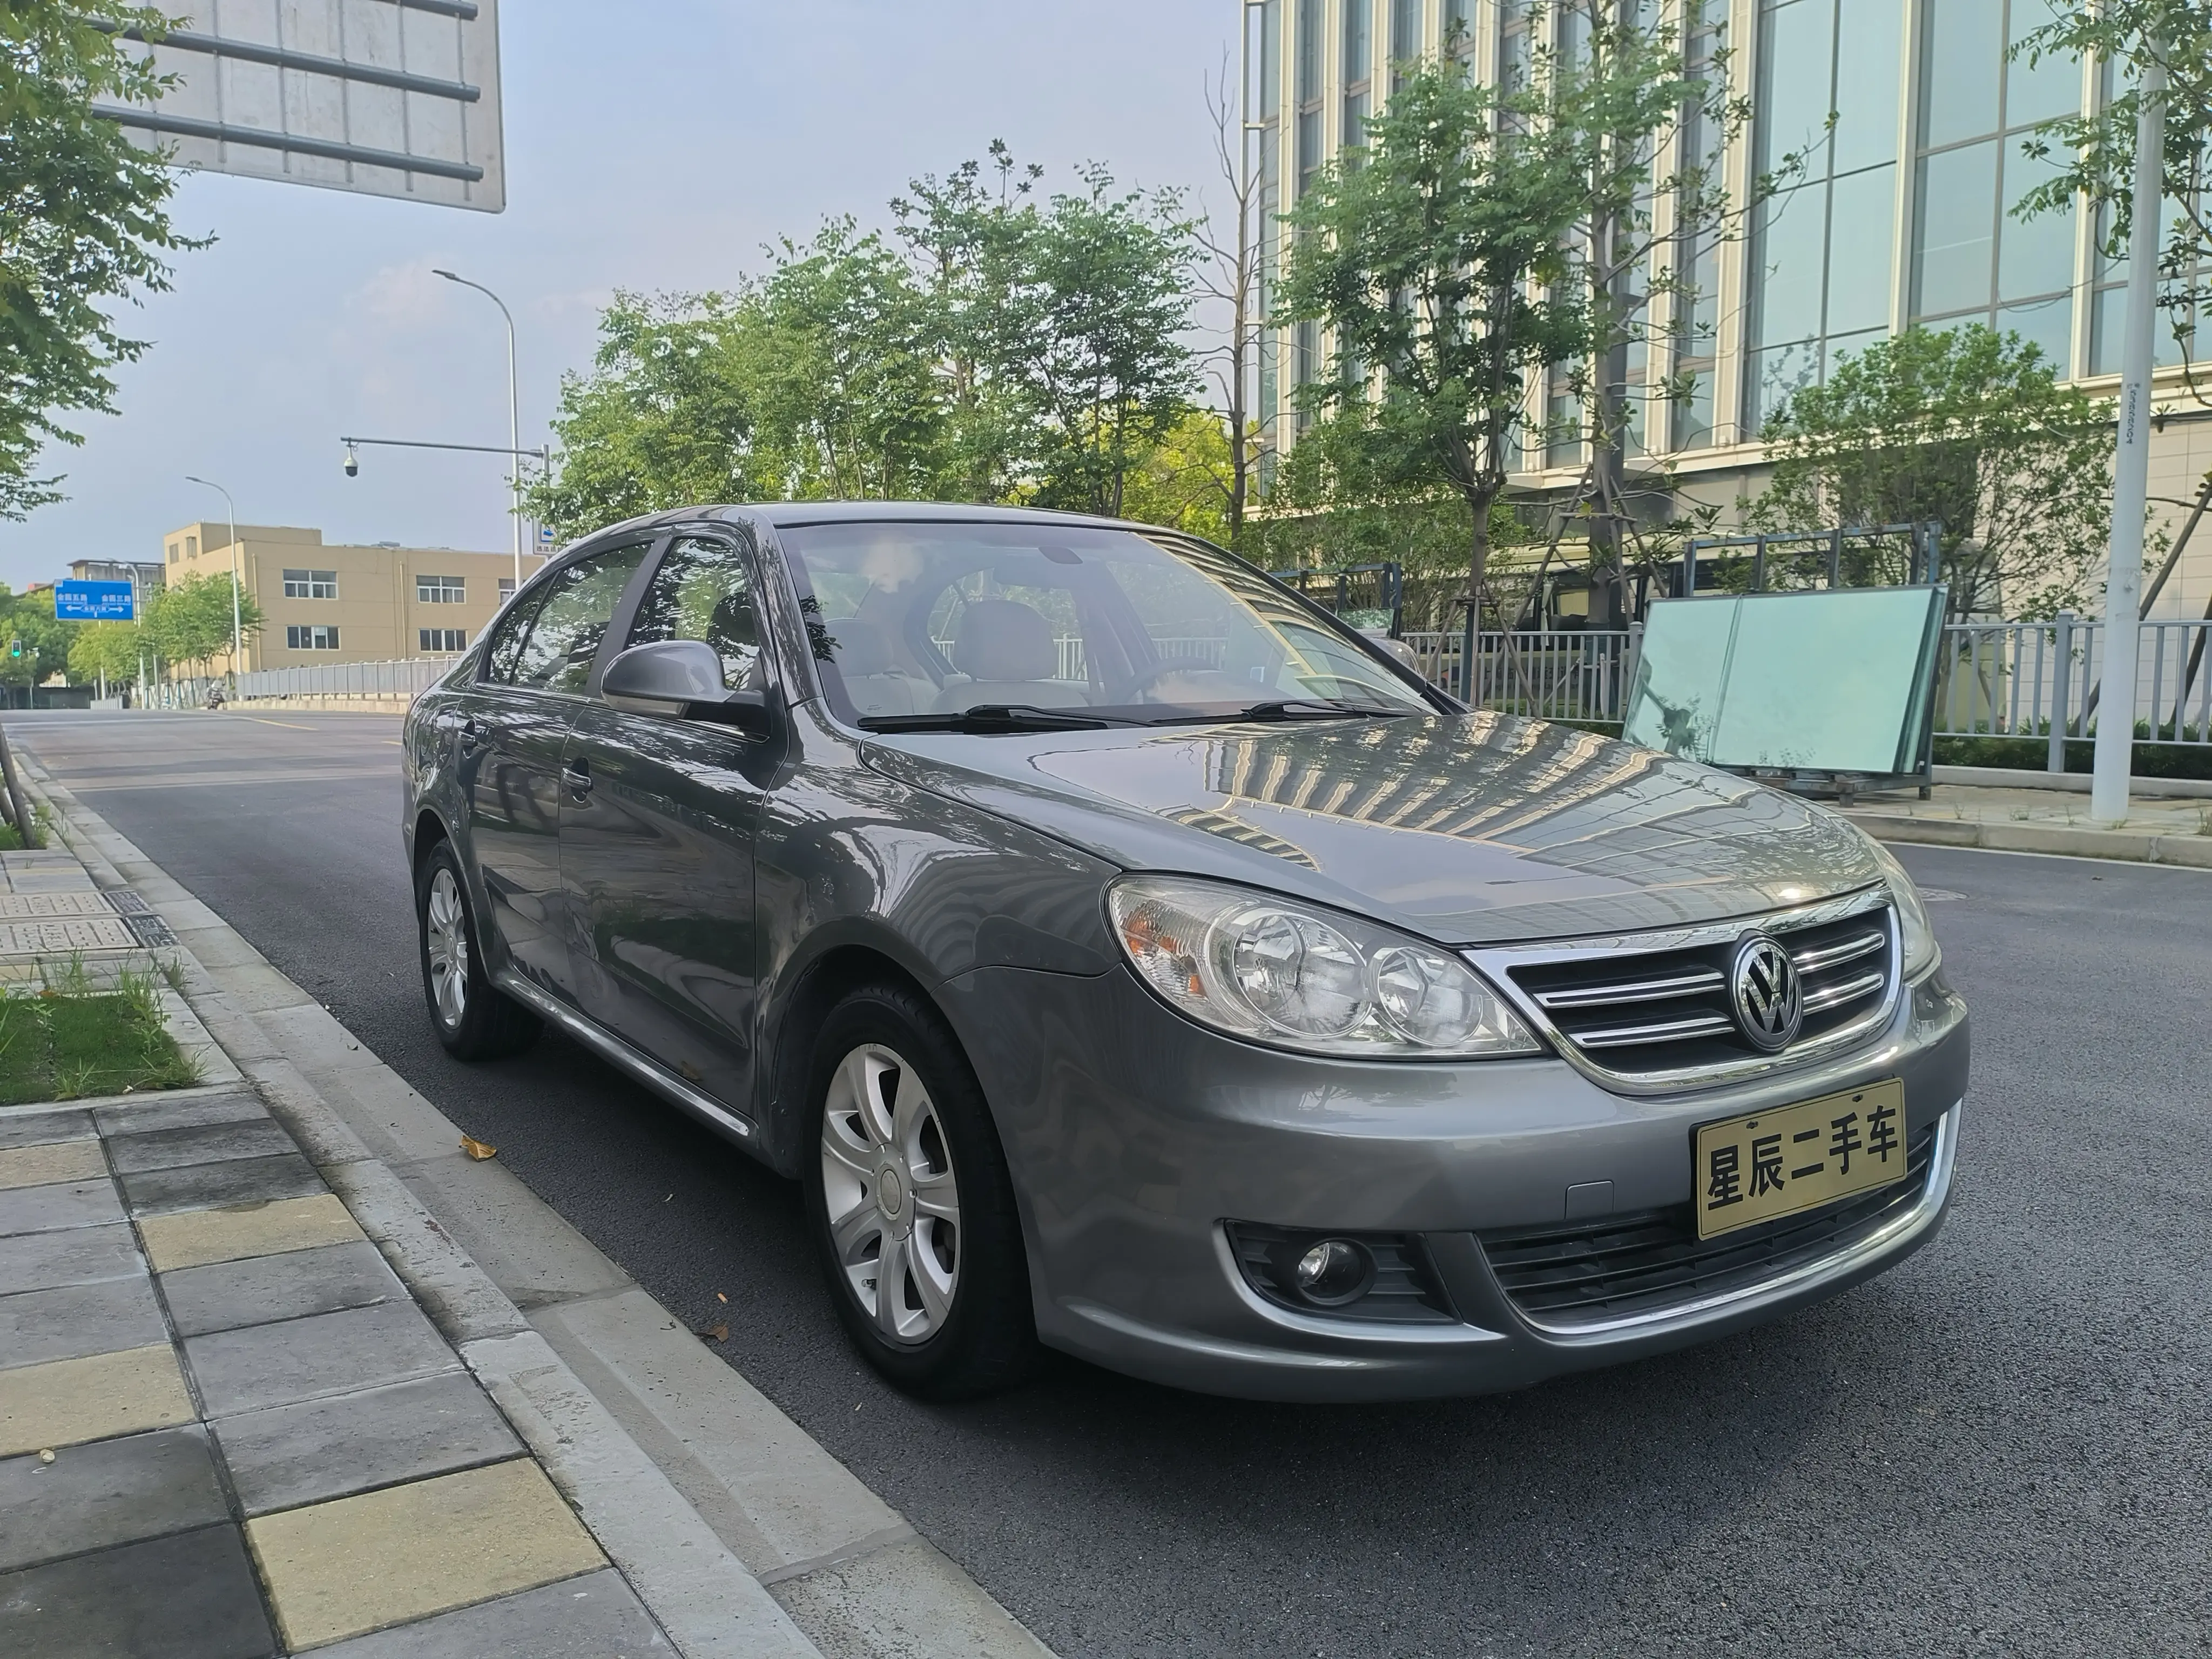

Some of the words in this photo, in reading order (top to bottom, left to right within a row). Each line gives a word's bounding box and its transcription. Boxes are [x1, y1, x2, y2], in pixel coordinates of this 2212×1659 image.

[1707, 1105, 1898, 1211] 星辰二手车
